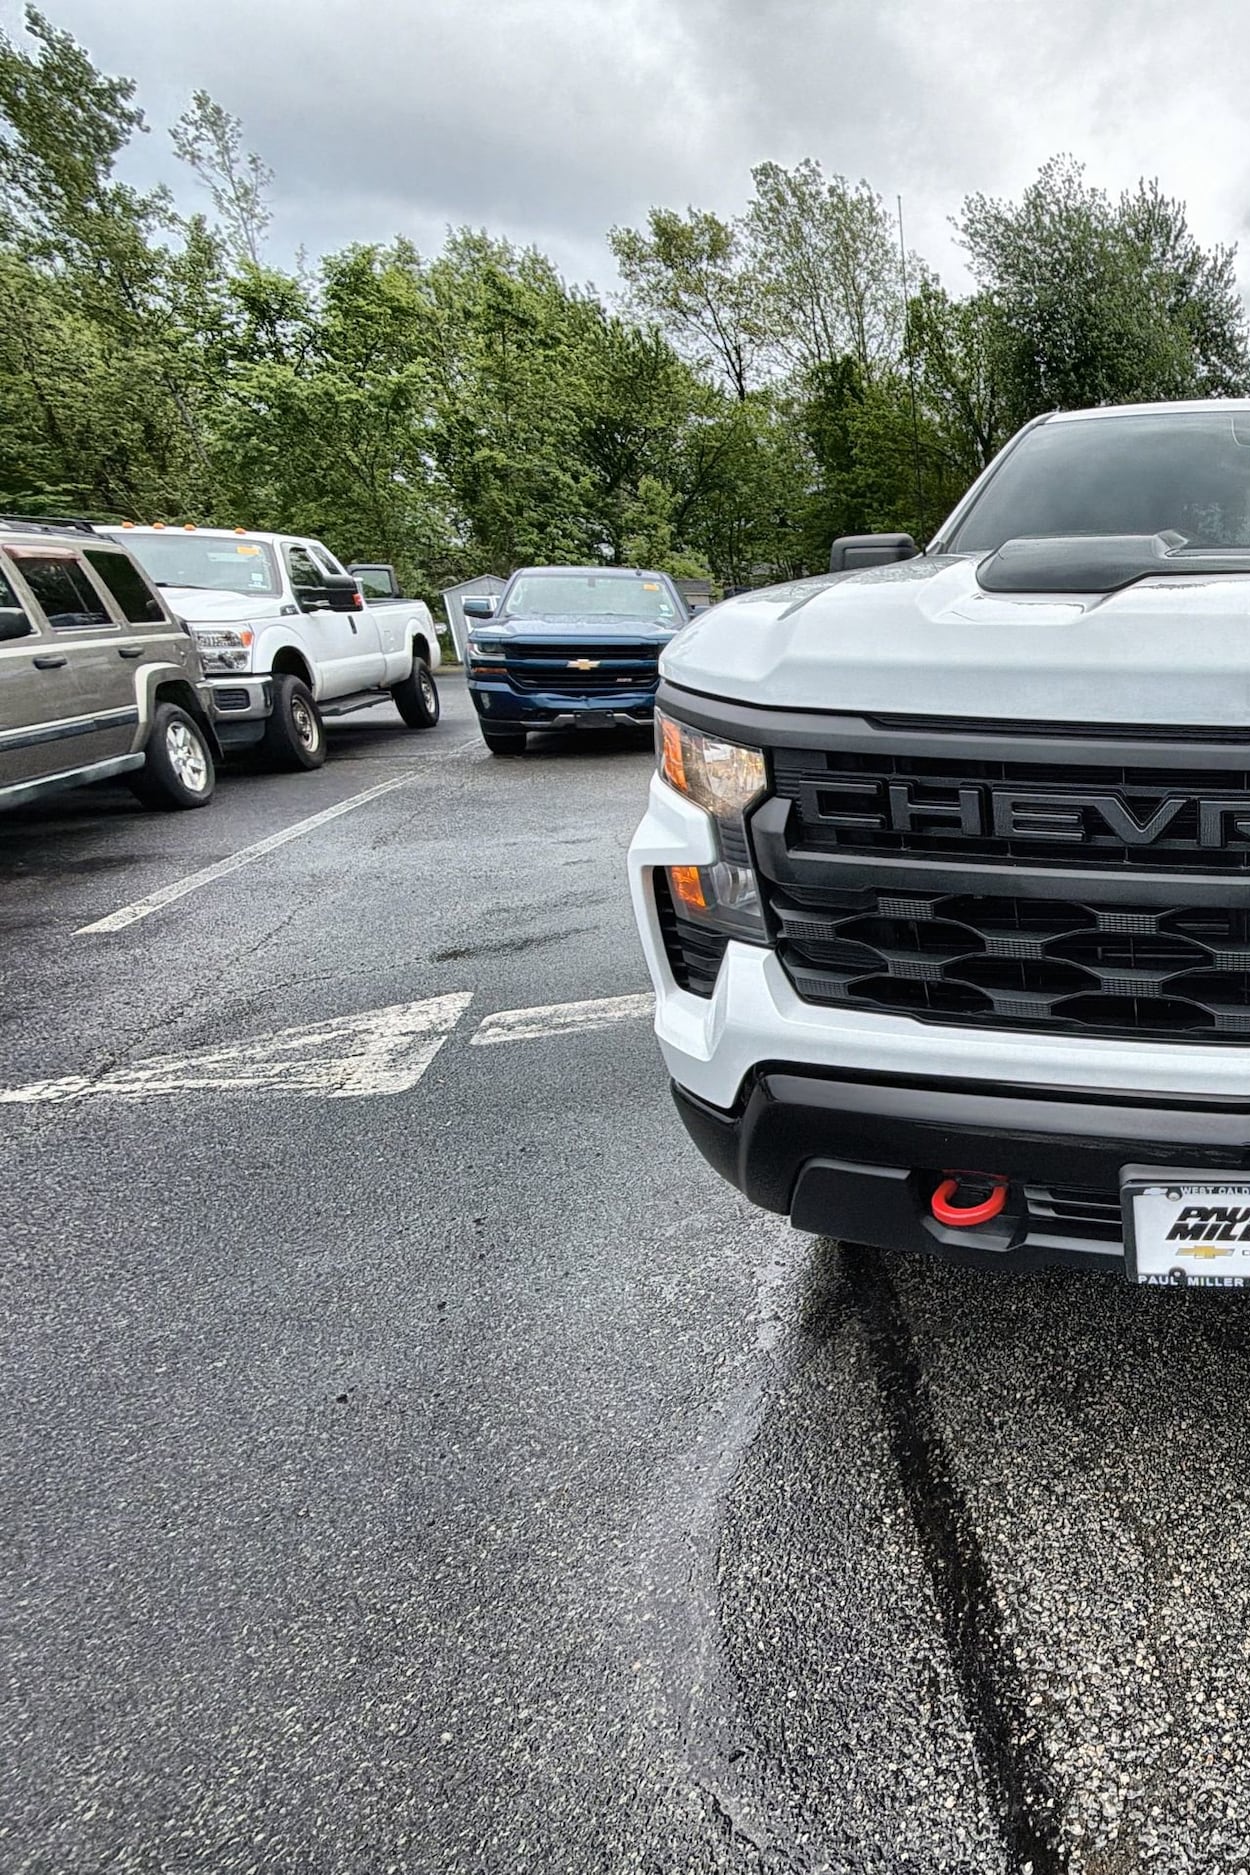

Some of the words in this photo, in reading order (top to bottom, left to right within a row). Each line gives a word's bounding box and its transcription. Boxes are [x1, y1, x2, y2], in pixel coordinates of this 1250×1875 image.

[1180, 1186, 1215, 1196] WEST
[1138, 1275, 1179, 1286] PAUL
[1187, 1277, 1244, 1288] MILLER
